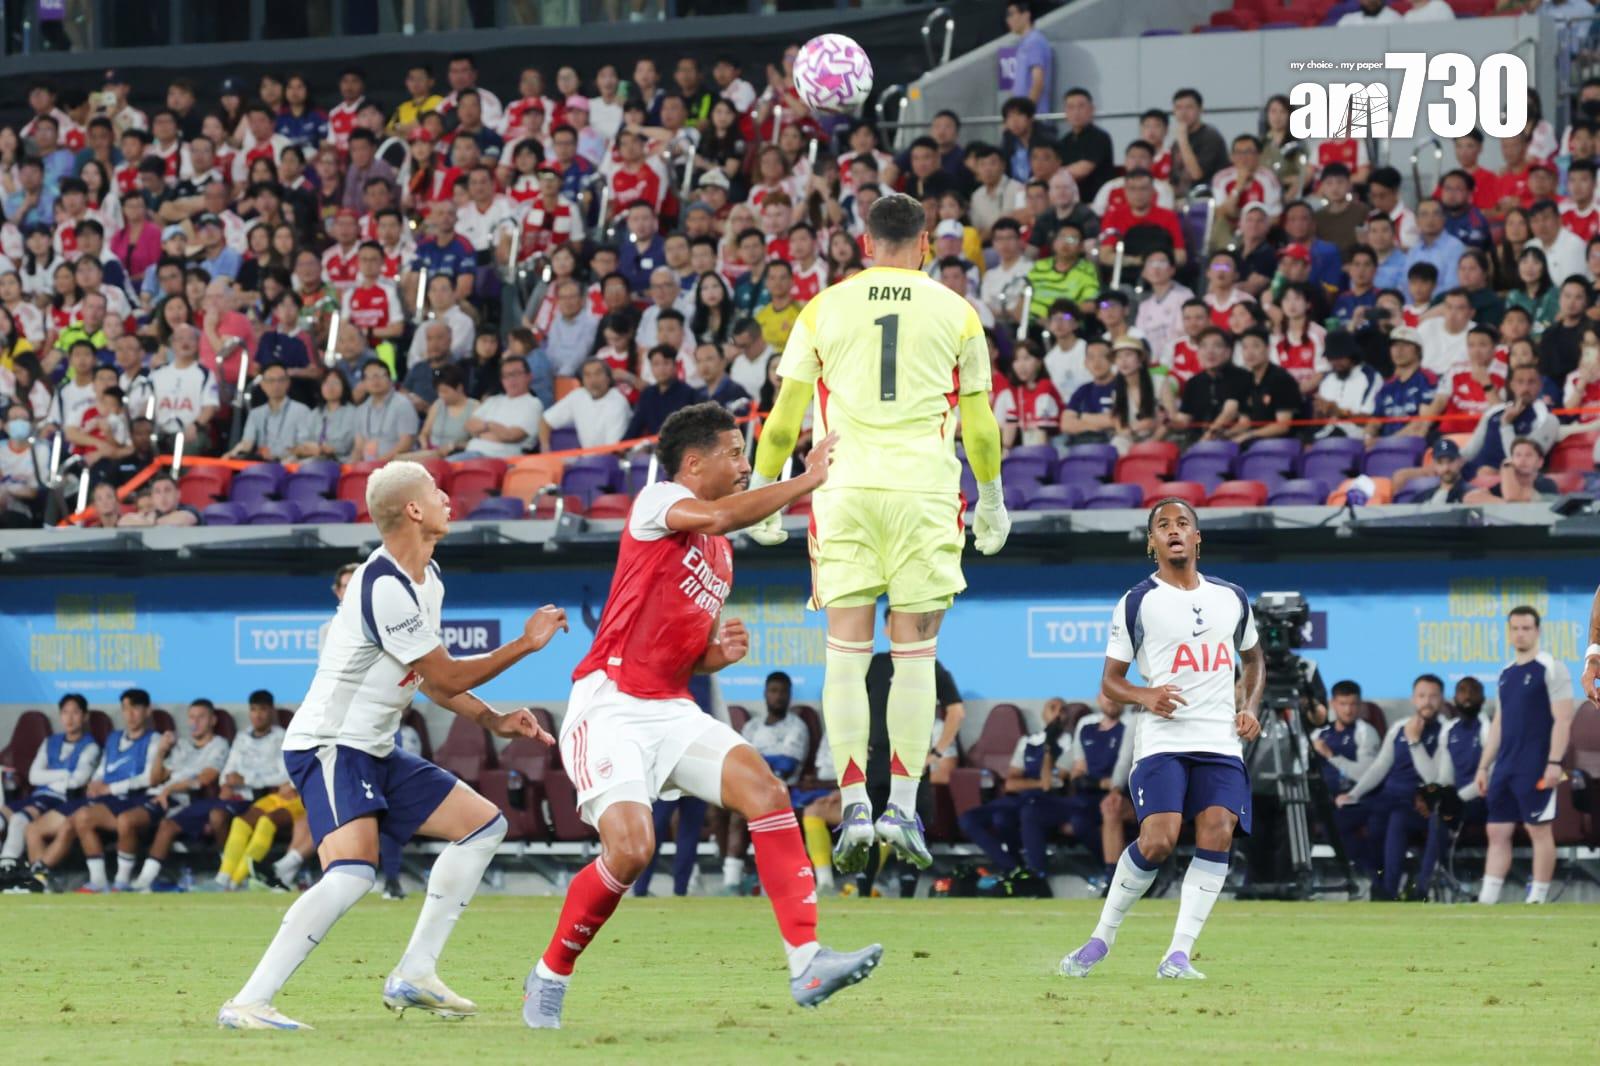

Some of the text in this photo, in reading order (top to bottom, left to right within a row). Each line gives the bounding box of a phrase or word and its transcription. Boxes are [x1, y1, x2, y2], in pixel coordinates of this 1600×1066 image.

[868, 286, 911, 301] RAYA
[874, 313, 899, 401] 1
[159, 396, 193, 411] AIA
[679, 575, 703, 598] FLY
[250, 626, 488, 651] TOTTE PUR
[1046, 621, 1113, 643] TOTT
[1419, 622, 1500, 663] FOOTBALL
[31, 633, 161, 672] FOOTBALL FESTIVAL
[765, 627, 827, 667] FESTIVA
[1171, 643, 1233, 673] AIA
